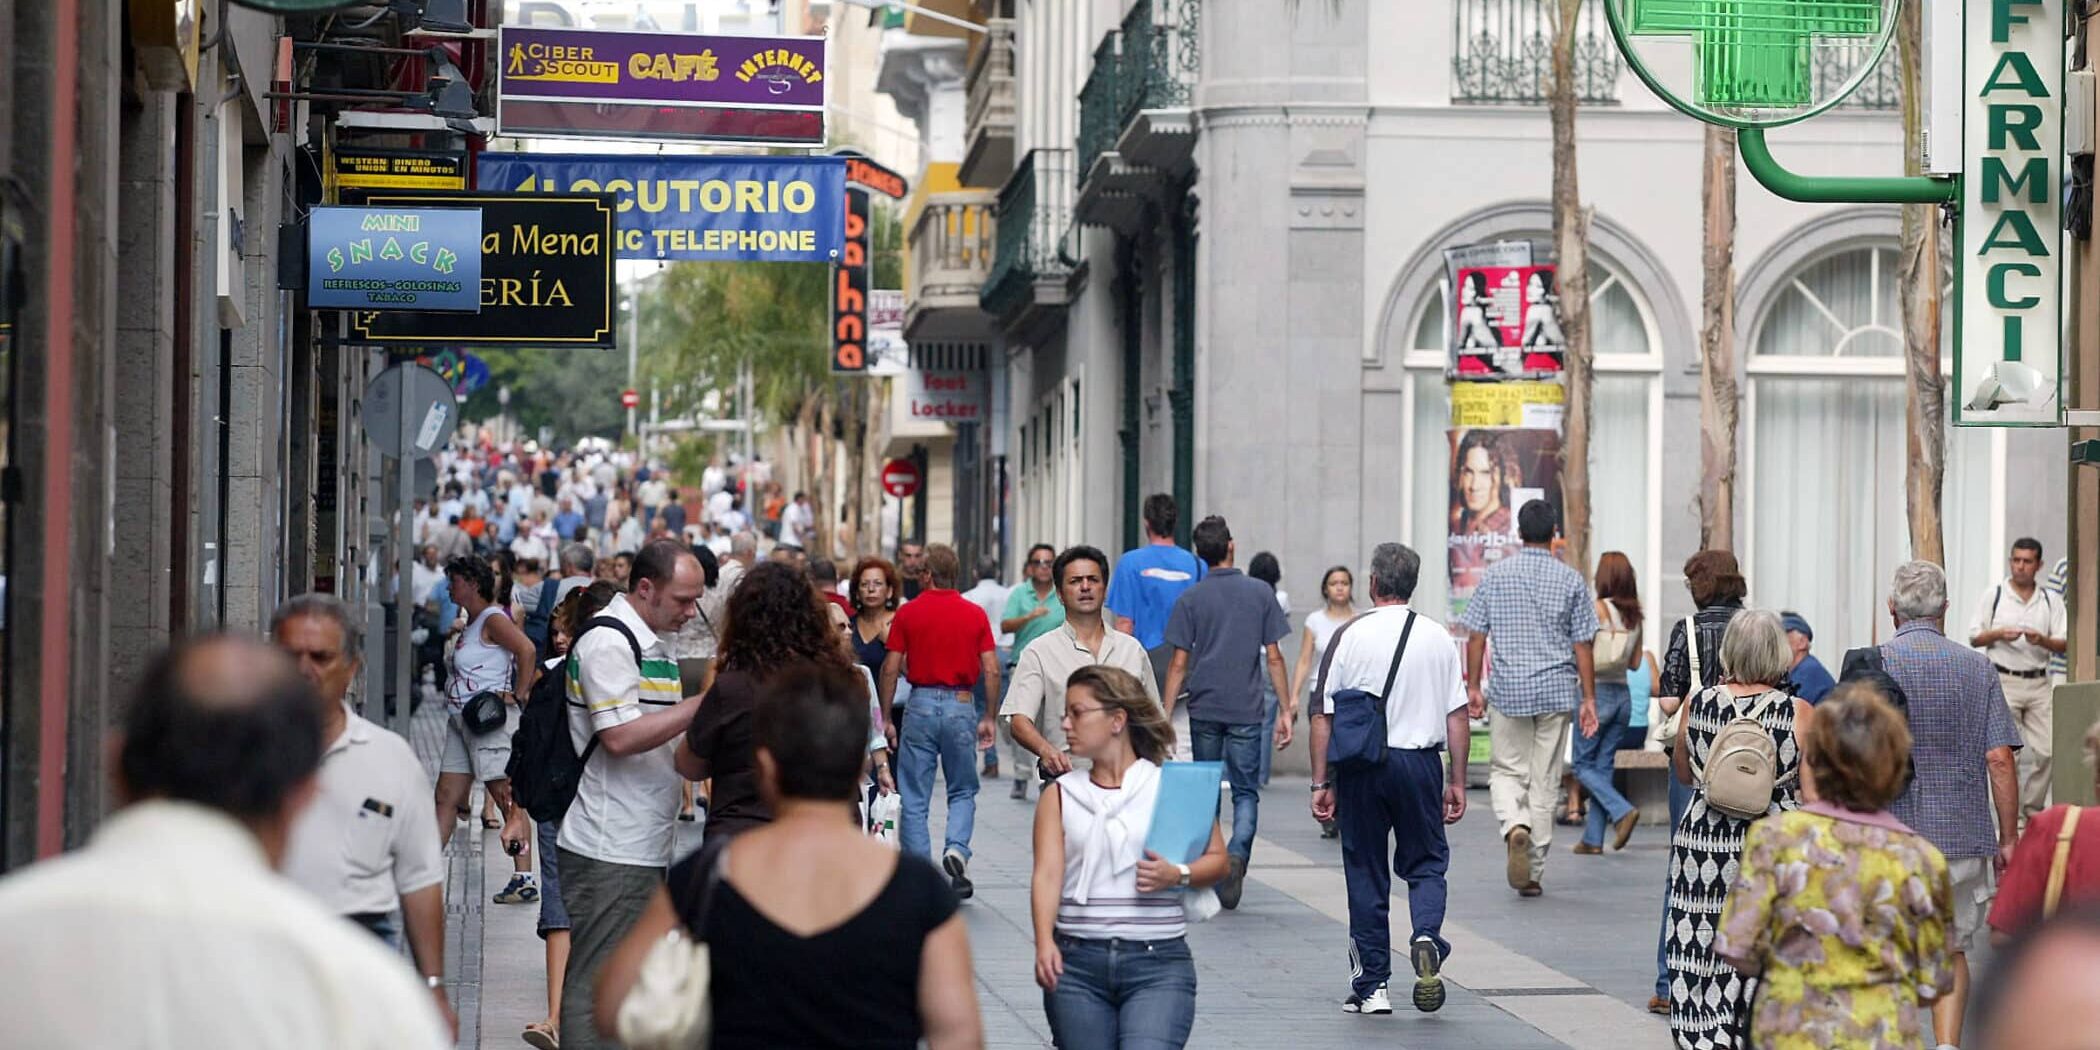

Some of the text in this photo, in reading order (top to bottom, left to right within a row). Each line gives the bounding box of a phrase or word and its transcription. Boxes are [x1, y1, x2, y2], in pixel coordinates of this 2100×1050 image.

[528, 43, 594, 60] CIBER
[546, 61, 616, 77] SCOUT
[628, 48, 719, 82] CAFÉ
[735, 48, 822, 83] INTERNET
[340, 157, 387, 165] WESTERN
[355, 164, 387, 172] UNION
[394, 158, 431, 166] DINERO
[410, 166, 455, 174] MINUTOS
[361, 214, 423, 232] MINI
[512, 224, 599, 257] Mena
[652, 229, 816, 252] TELEPHONE
[327, 237, 457, 274] SNACK
[367, 292, 416, 303] TABACO
[922, 370, 966, 391] Foot
[911, 399, 978, 417] Locker
